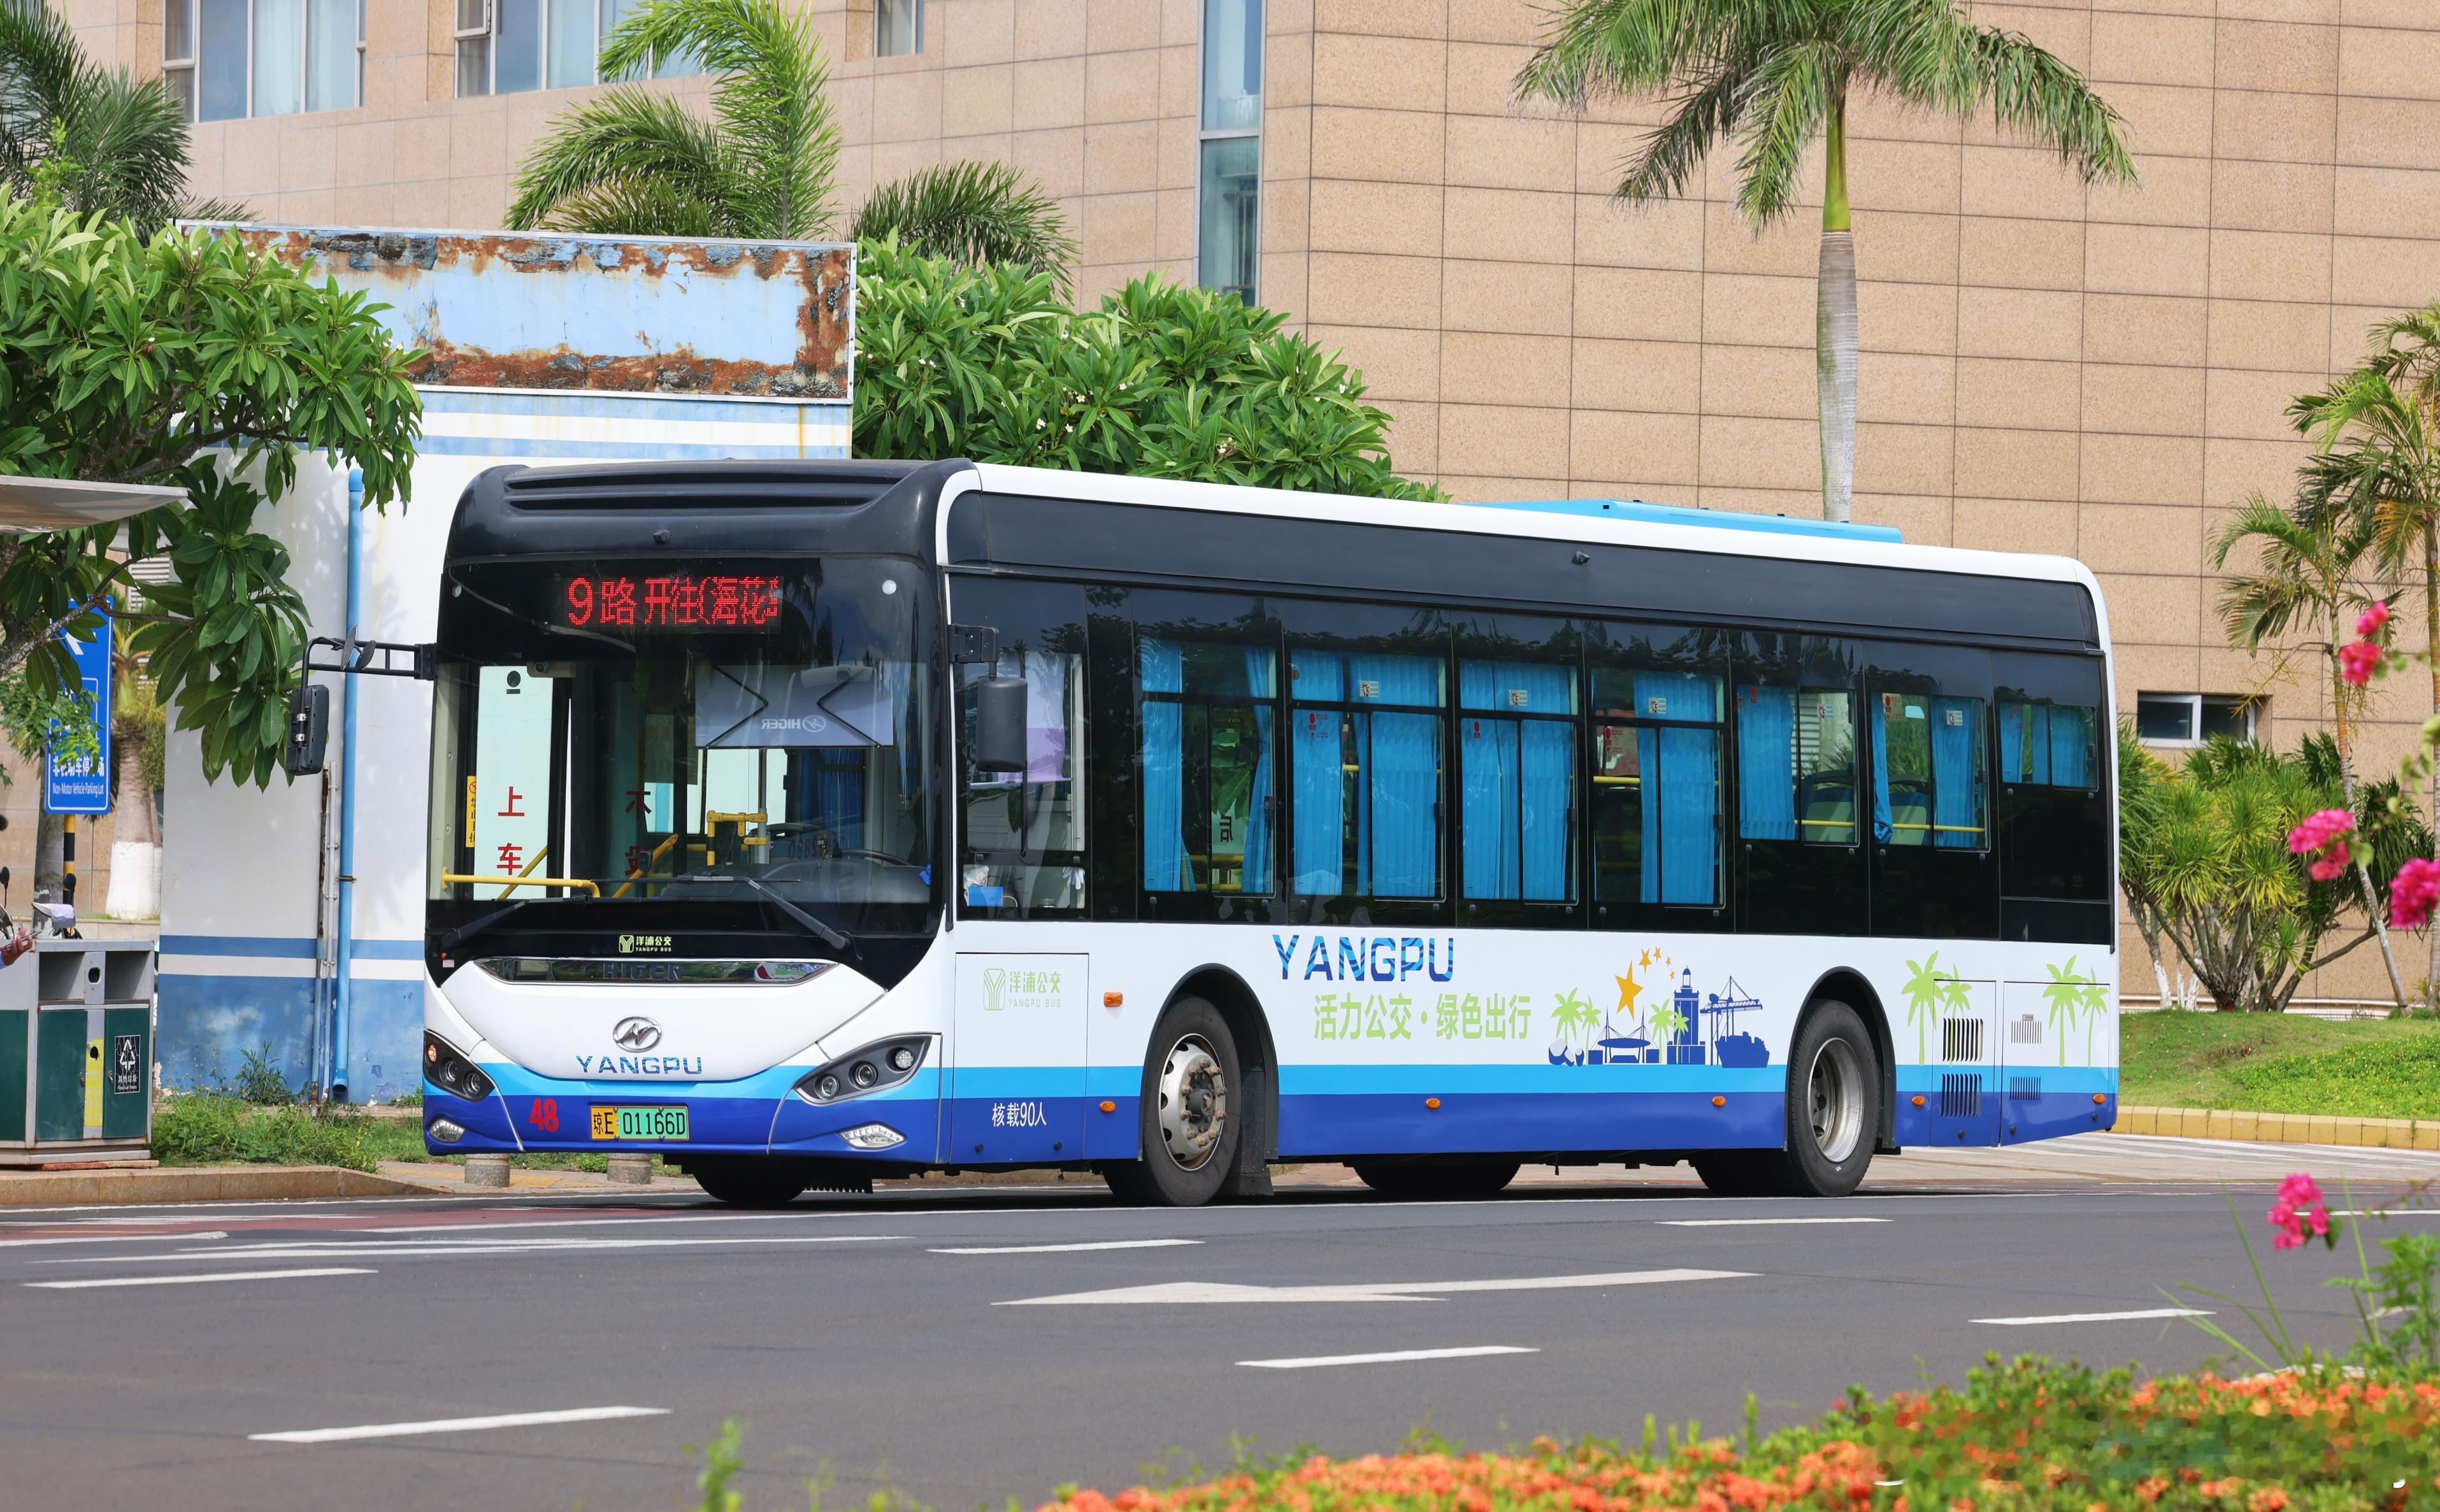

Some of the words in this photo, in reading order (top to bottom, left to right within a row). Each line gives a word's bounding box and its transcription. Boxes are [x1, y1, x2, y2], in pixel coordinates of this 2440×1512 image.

[52, 782, 72, 795] Non-Motor
[73, 781, 85, 795] Vehicle
[85, 781, 98, 798] Parking
[636, 936, 672, 946] 洋浦公交
[1272, 934, 1454, 982] YANGPU
[603, 962, 684, 981] HIGER
[1010, 971, 1061, 993] 洋浦公交
[1008, 998, 1041, 1008] YANGPU
[1045, 998, 1061, 1008] BUS
[575, 1055, 702, 1075] YANGPU
[529, 1097, 559, 1132] 48
[992, 1101, 1047, 1127] 核载90人
